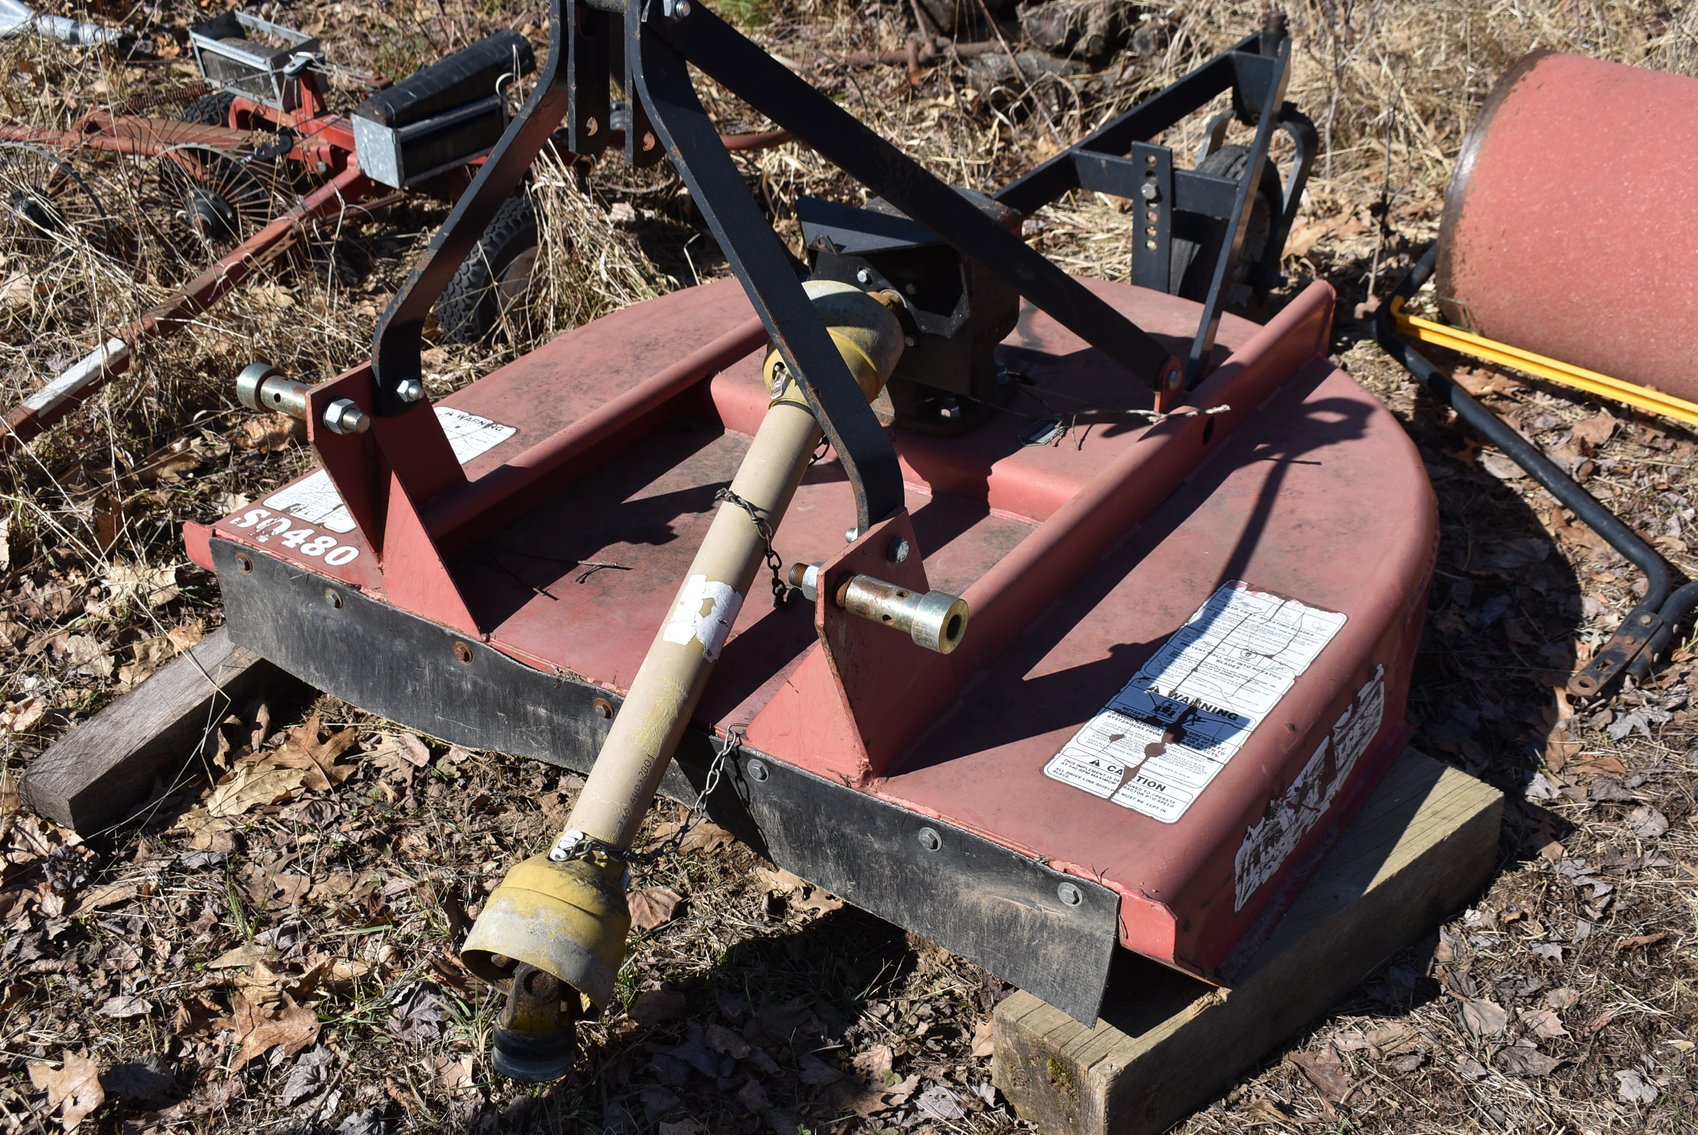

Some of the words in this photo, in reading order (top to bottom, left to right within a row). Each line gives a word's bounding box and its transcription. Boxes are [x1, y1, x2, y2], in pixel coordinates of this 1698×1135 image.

[456, 413, 504, 432] WARNING
[230, 509, 360, 566] SQ480
[1215, 659, 1240, 669] BLADES
[1251, 667, 1283, 680] ROTATING
[1107, 715, 1145, 730] BYSTANDERS
[1145, 728, 1162, 736] FROM
[1076, 764, 1106, 777] IMPLEMENT
[1090, 773, 1116, 785] MAXIMUM
[1107, 765, 1166, 792] CATION
[1120, 793, 1136, 801] MUST
